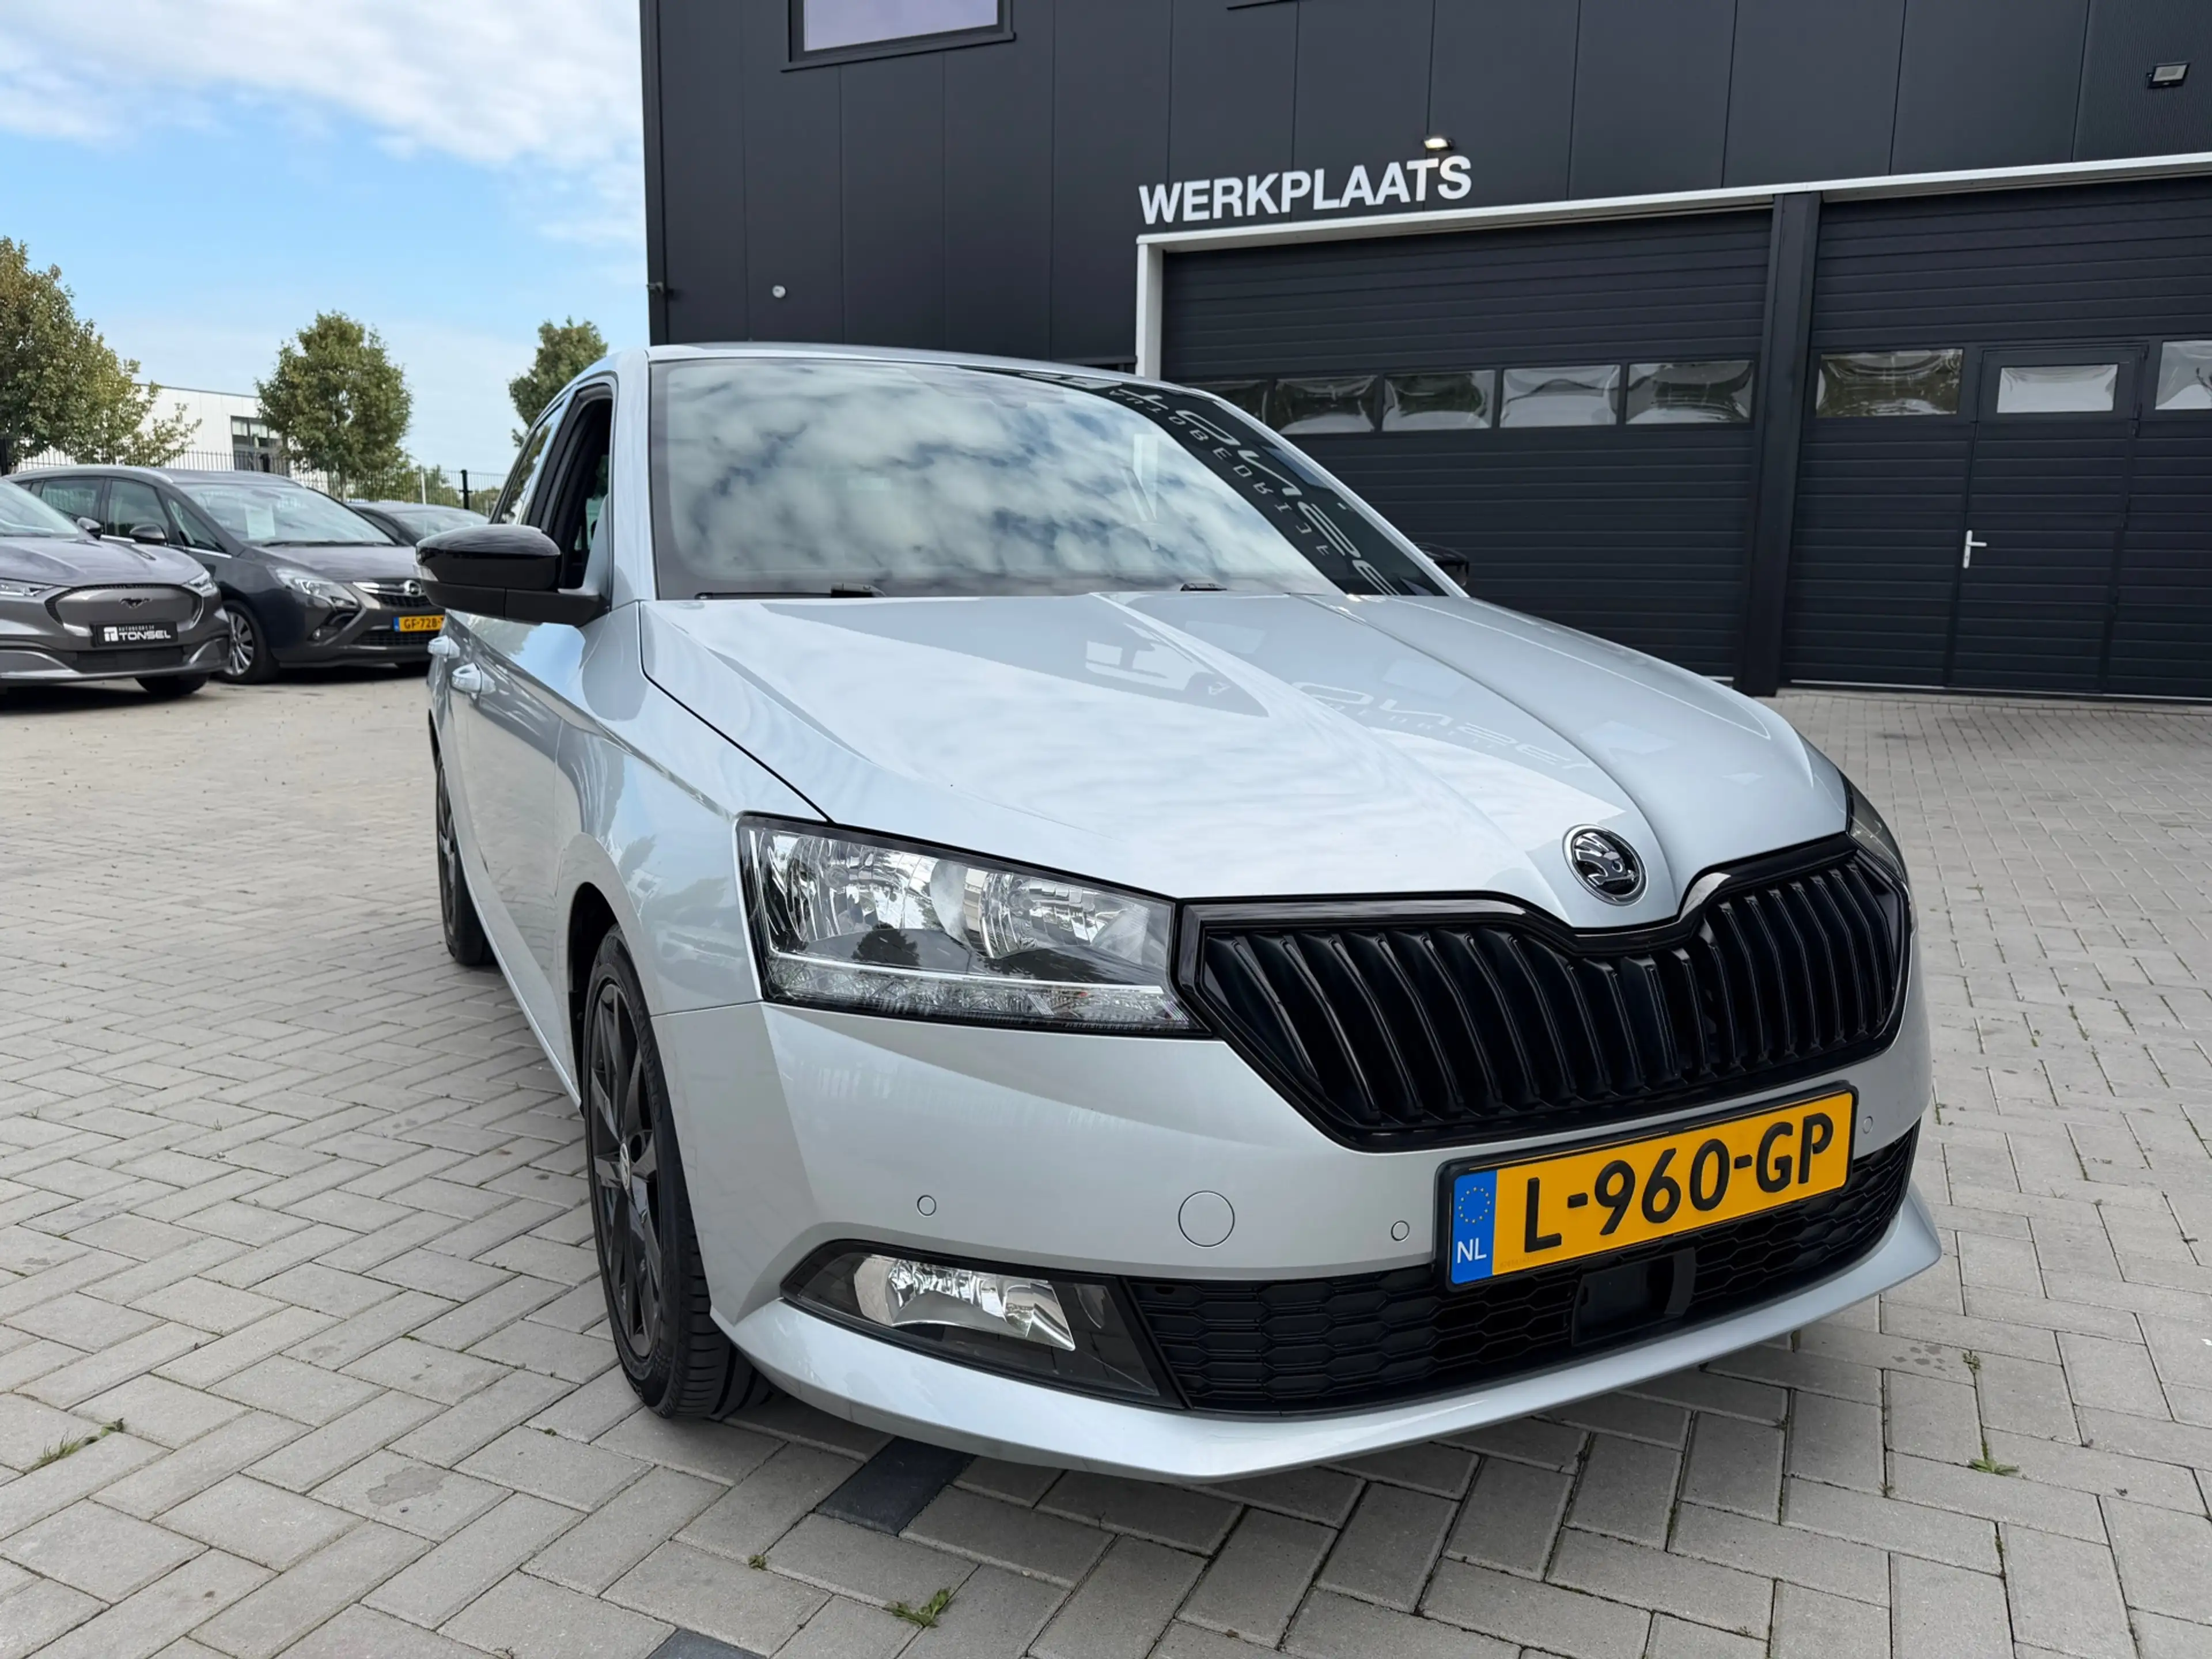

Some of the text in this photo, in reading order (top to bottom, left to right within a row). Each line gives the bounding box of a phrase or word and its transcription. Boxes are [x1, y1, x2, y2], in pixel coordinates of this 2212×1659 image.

[1139, 156, 1471, 224] WERKPLAATS
[119, 630, 172, 641] TONSEL
[1524, 1112, 1834, 1253] L-960-GP
[1457, 1238, 1487, 1264] NL
